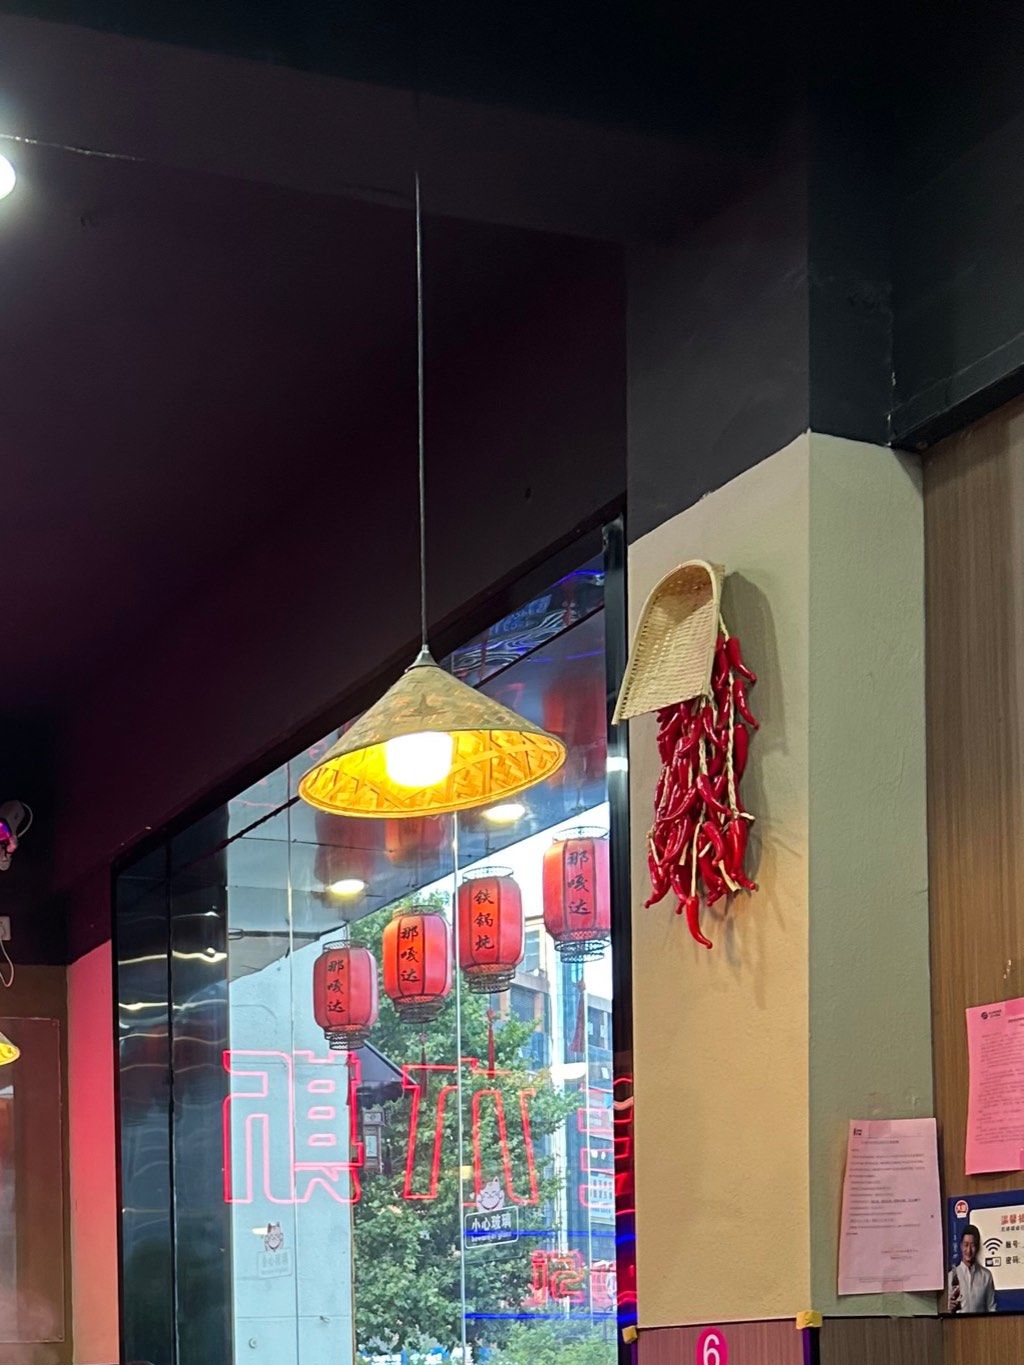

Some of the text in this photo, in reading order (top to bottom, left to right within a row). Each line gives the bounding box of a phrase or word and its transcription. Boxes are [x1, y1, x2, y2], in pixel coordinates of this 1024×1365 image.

[473, 889, 495, 951] 铁锅炖
[471, 1212, 512, 1232] 小心玻璃
